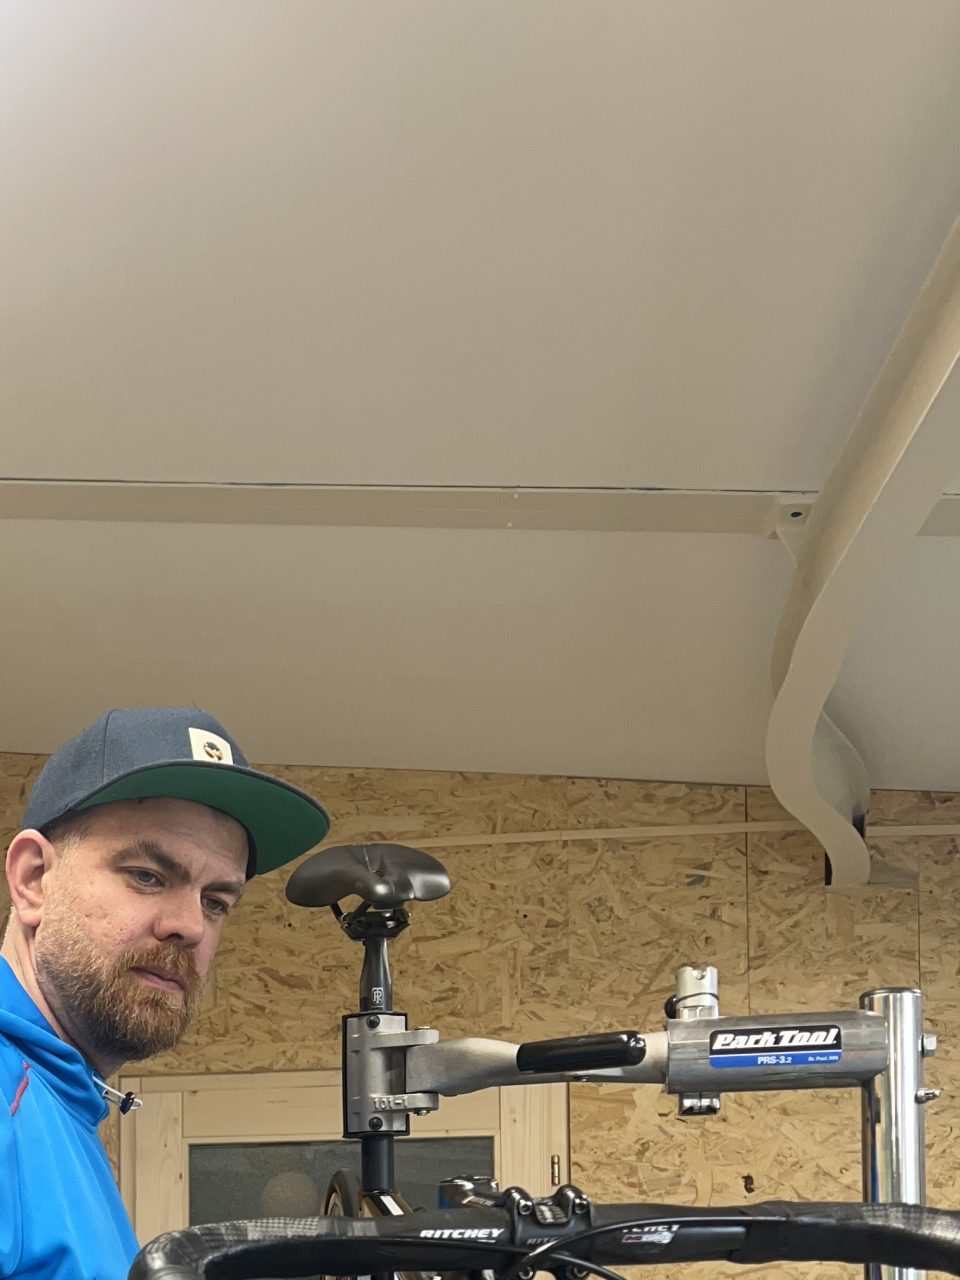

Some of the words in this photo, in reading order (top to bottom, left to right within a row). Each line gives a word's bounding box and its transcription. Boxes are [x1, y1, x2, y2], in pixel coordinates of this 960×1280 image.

[712, 1031, 777, 1050] Park
[757, 1055, 792, 1065] PRS-3.2
[419, 1228, 505, 1239] RITCHEY
